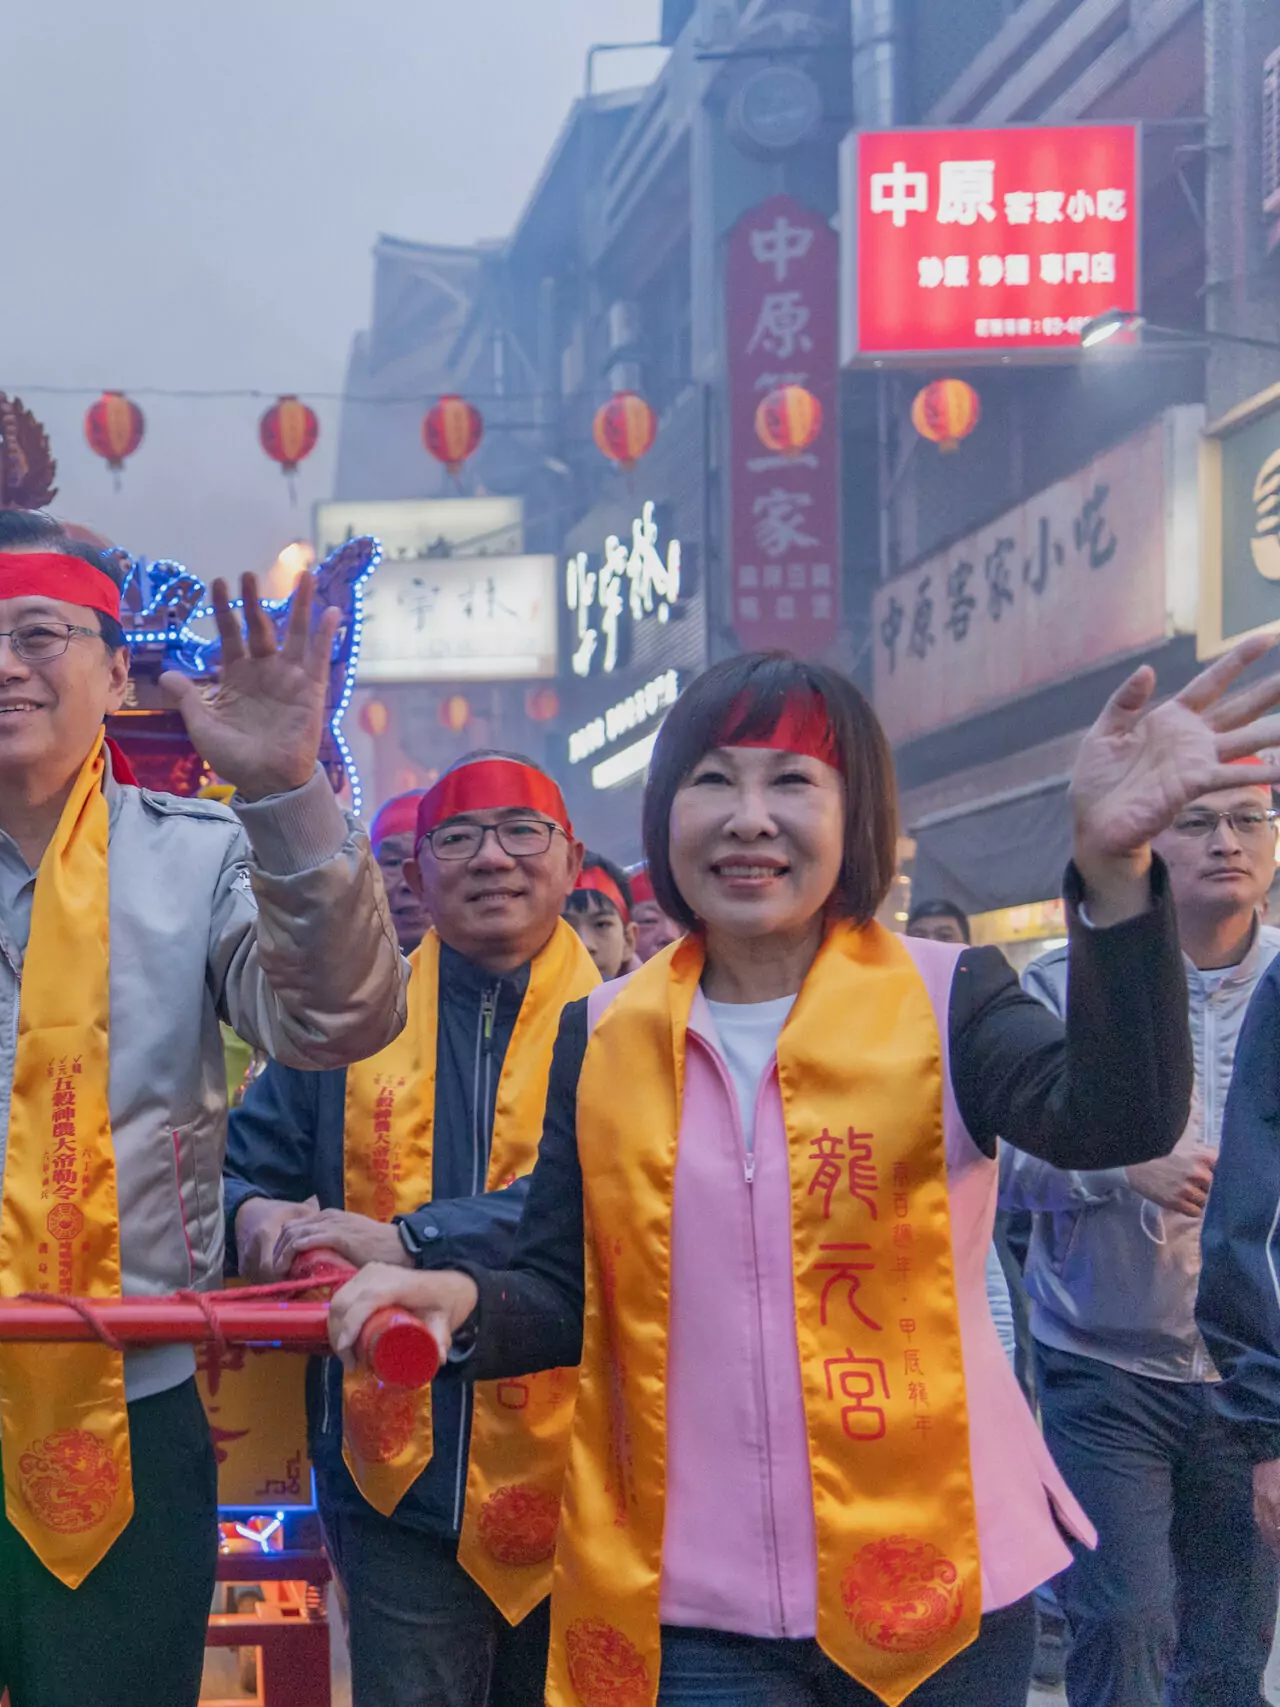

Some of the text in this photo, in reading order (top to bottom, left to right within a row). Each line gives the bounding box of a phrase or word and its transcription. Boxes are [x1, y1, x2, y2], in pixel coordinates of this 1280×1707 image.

[870, 160, 1127, 227] 中原 客家小吃
[744, 215, 820, 559] 中原一家
[879, 483, 1118, 675] 中原客家小吃
[807, 1126, 891, 1442] 龍元宮
